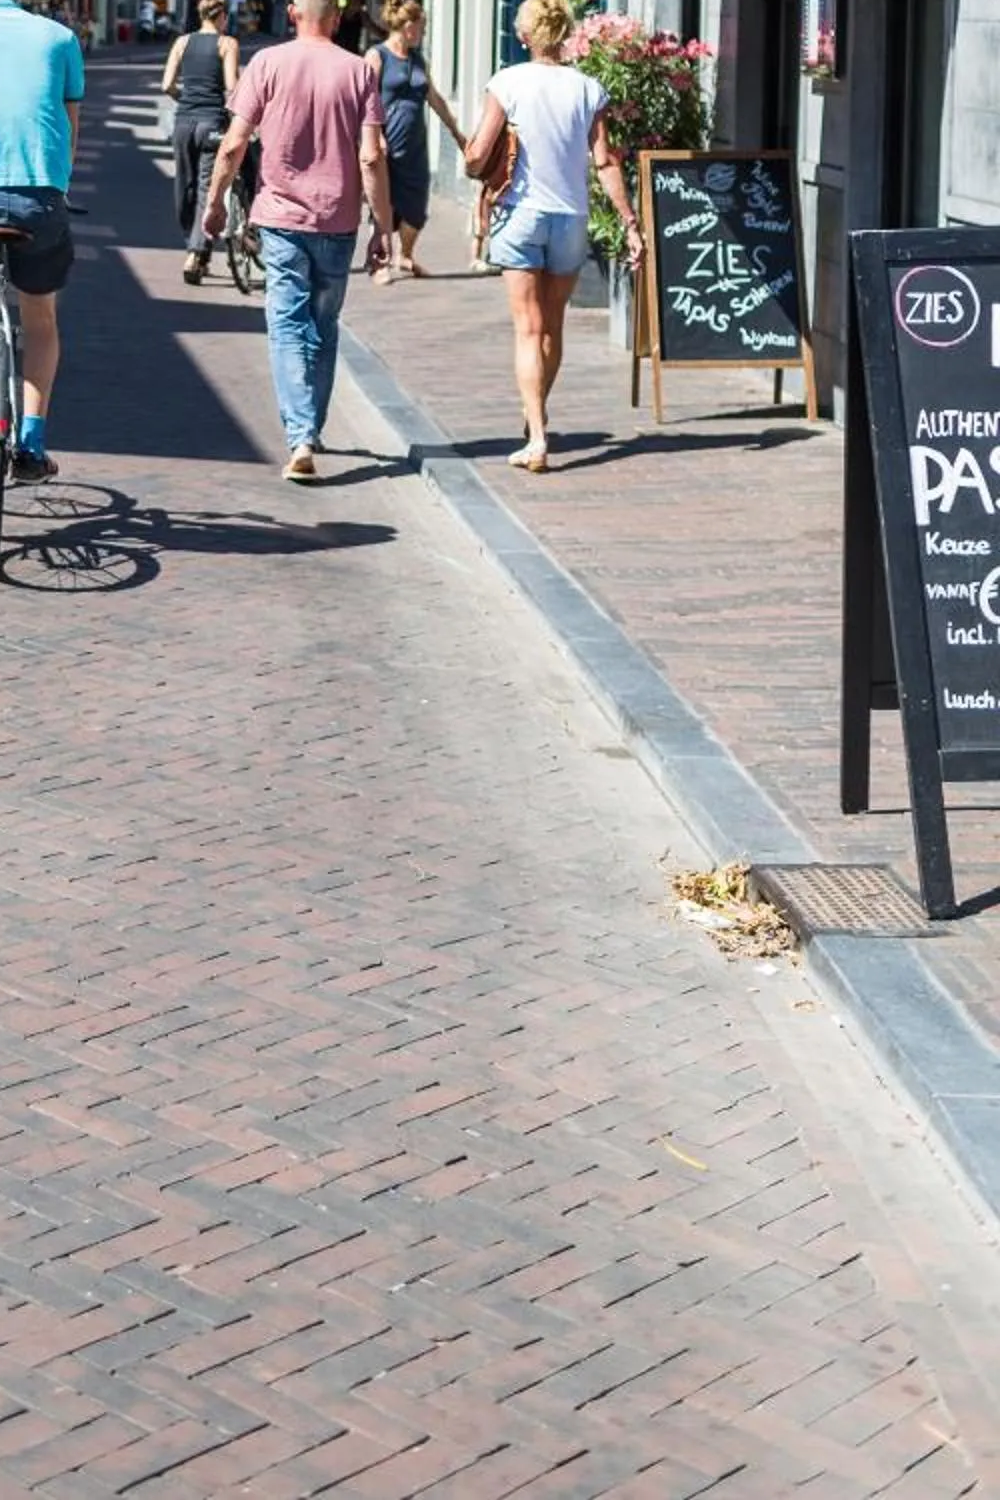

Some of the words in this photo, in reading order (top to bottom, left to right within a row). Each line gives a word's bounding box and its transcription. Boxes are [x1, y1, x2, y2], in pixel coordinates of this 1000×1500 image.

[905, 290, 965, 324] ZIES
[925, 531, 992, 555] Keuze
[946, 621, 993, 645] incl.
[943, 688, 996, 709] Lunch
